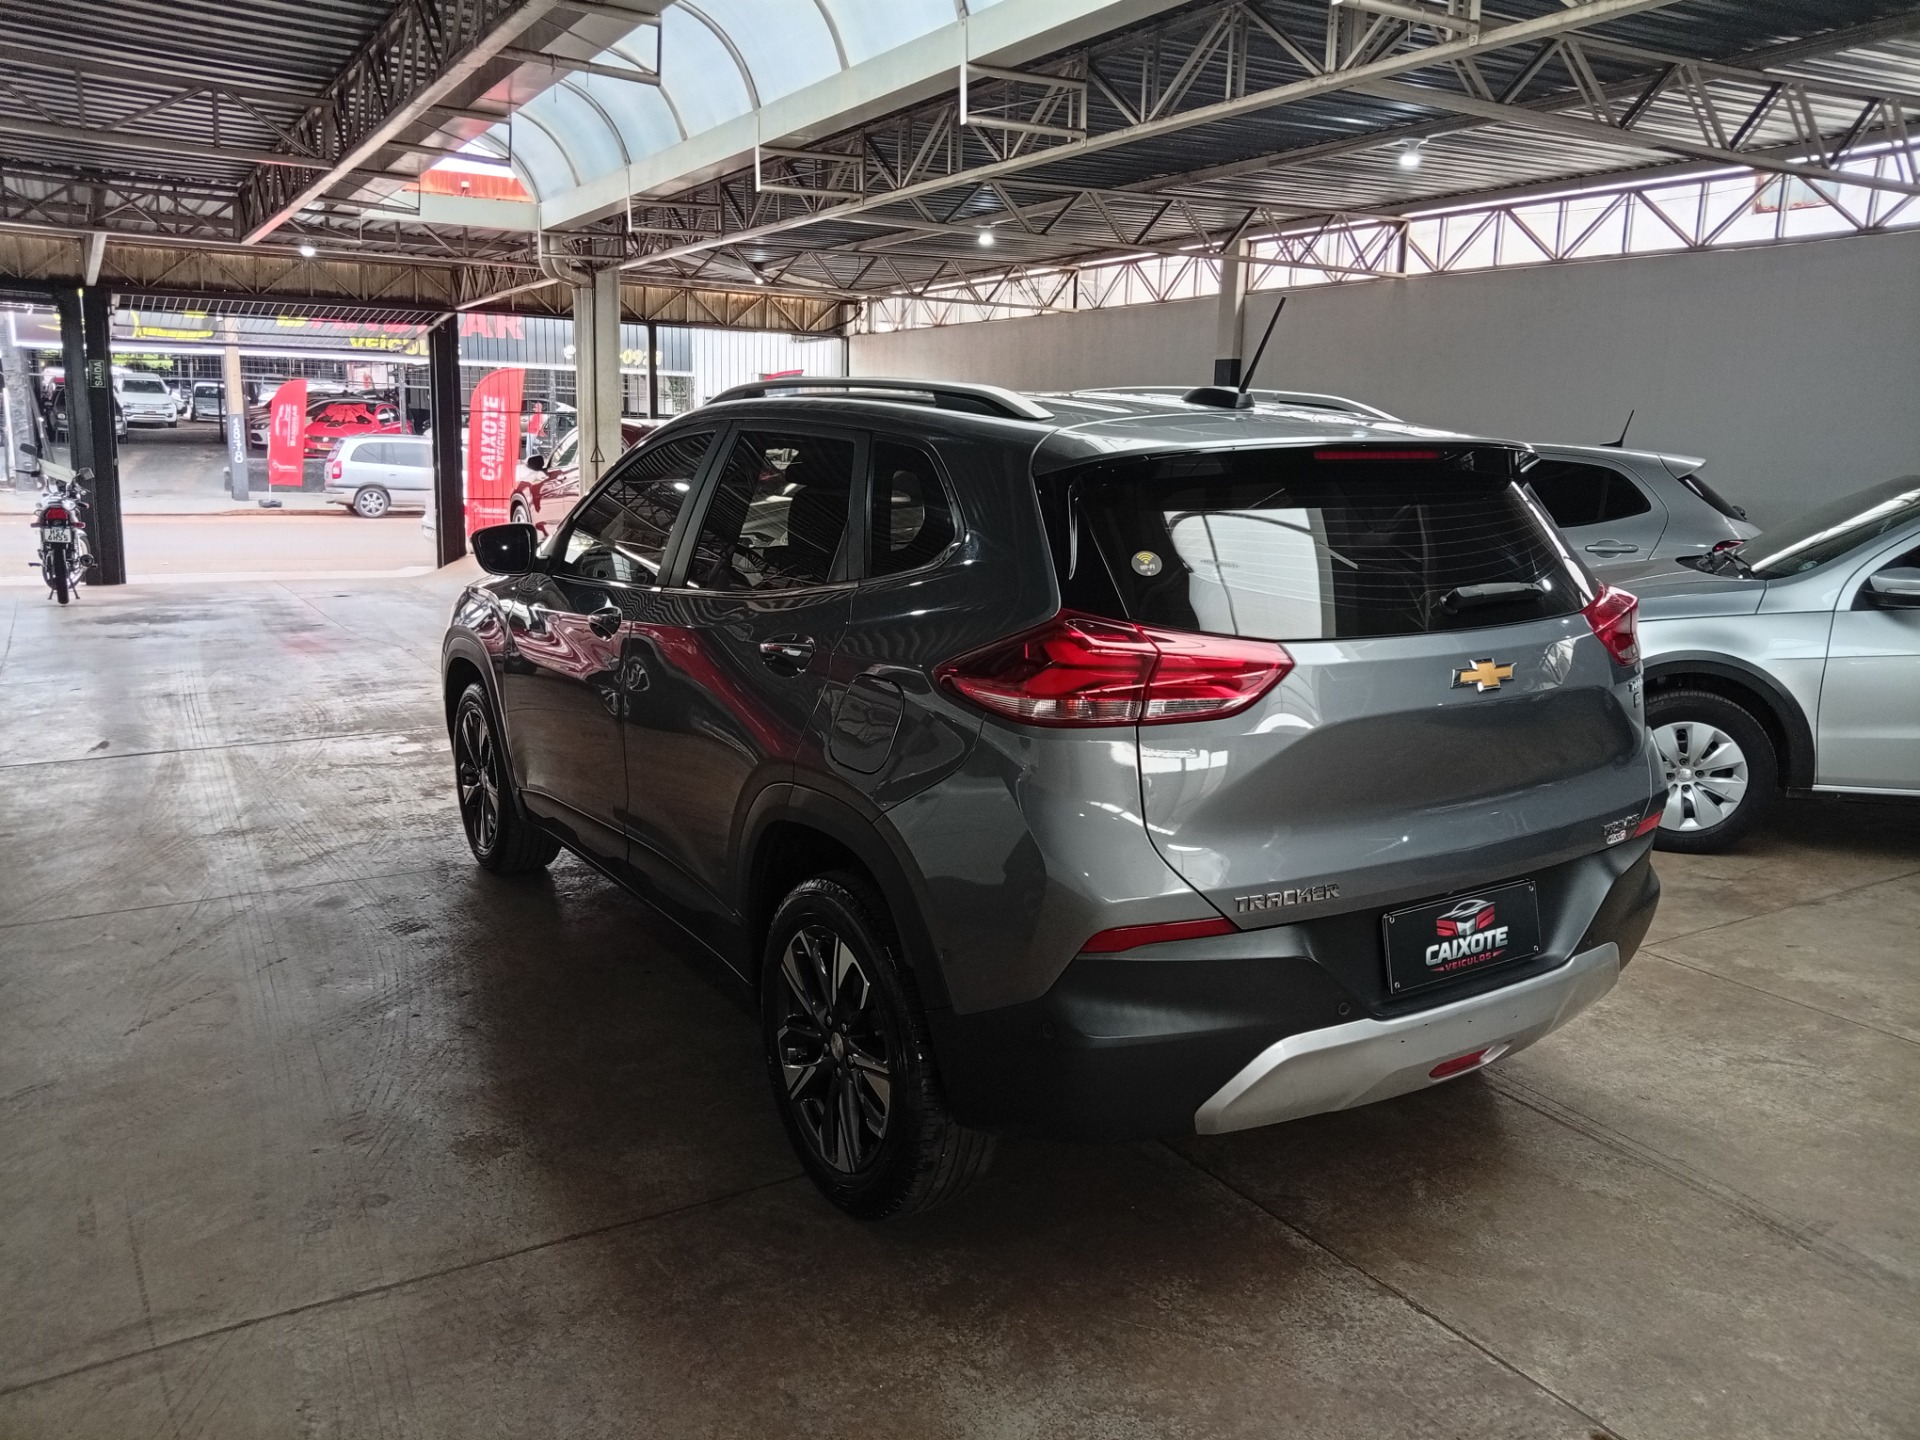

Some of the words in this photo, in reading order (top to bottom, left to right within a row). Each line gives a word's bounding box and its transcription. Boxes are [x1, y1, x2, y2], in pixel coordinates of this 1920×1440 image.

[479, 395, 499, 481] CAIXOTE
[1234, 883, 1340, 913] TRACKER
[1425, 926, 1508, 966] CAIXOTE
